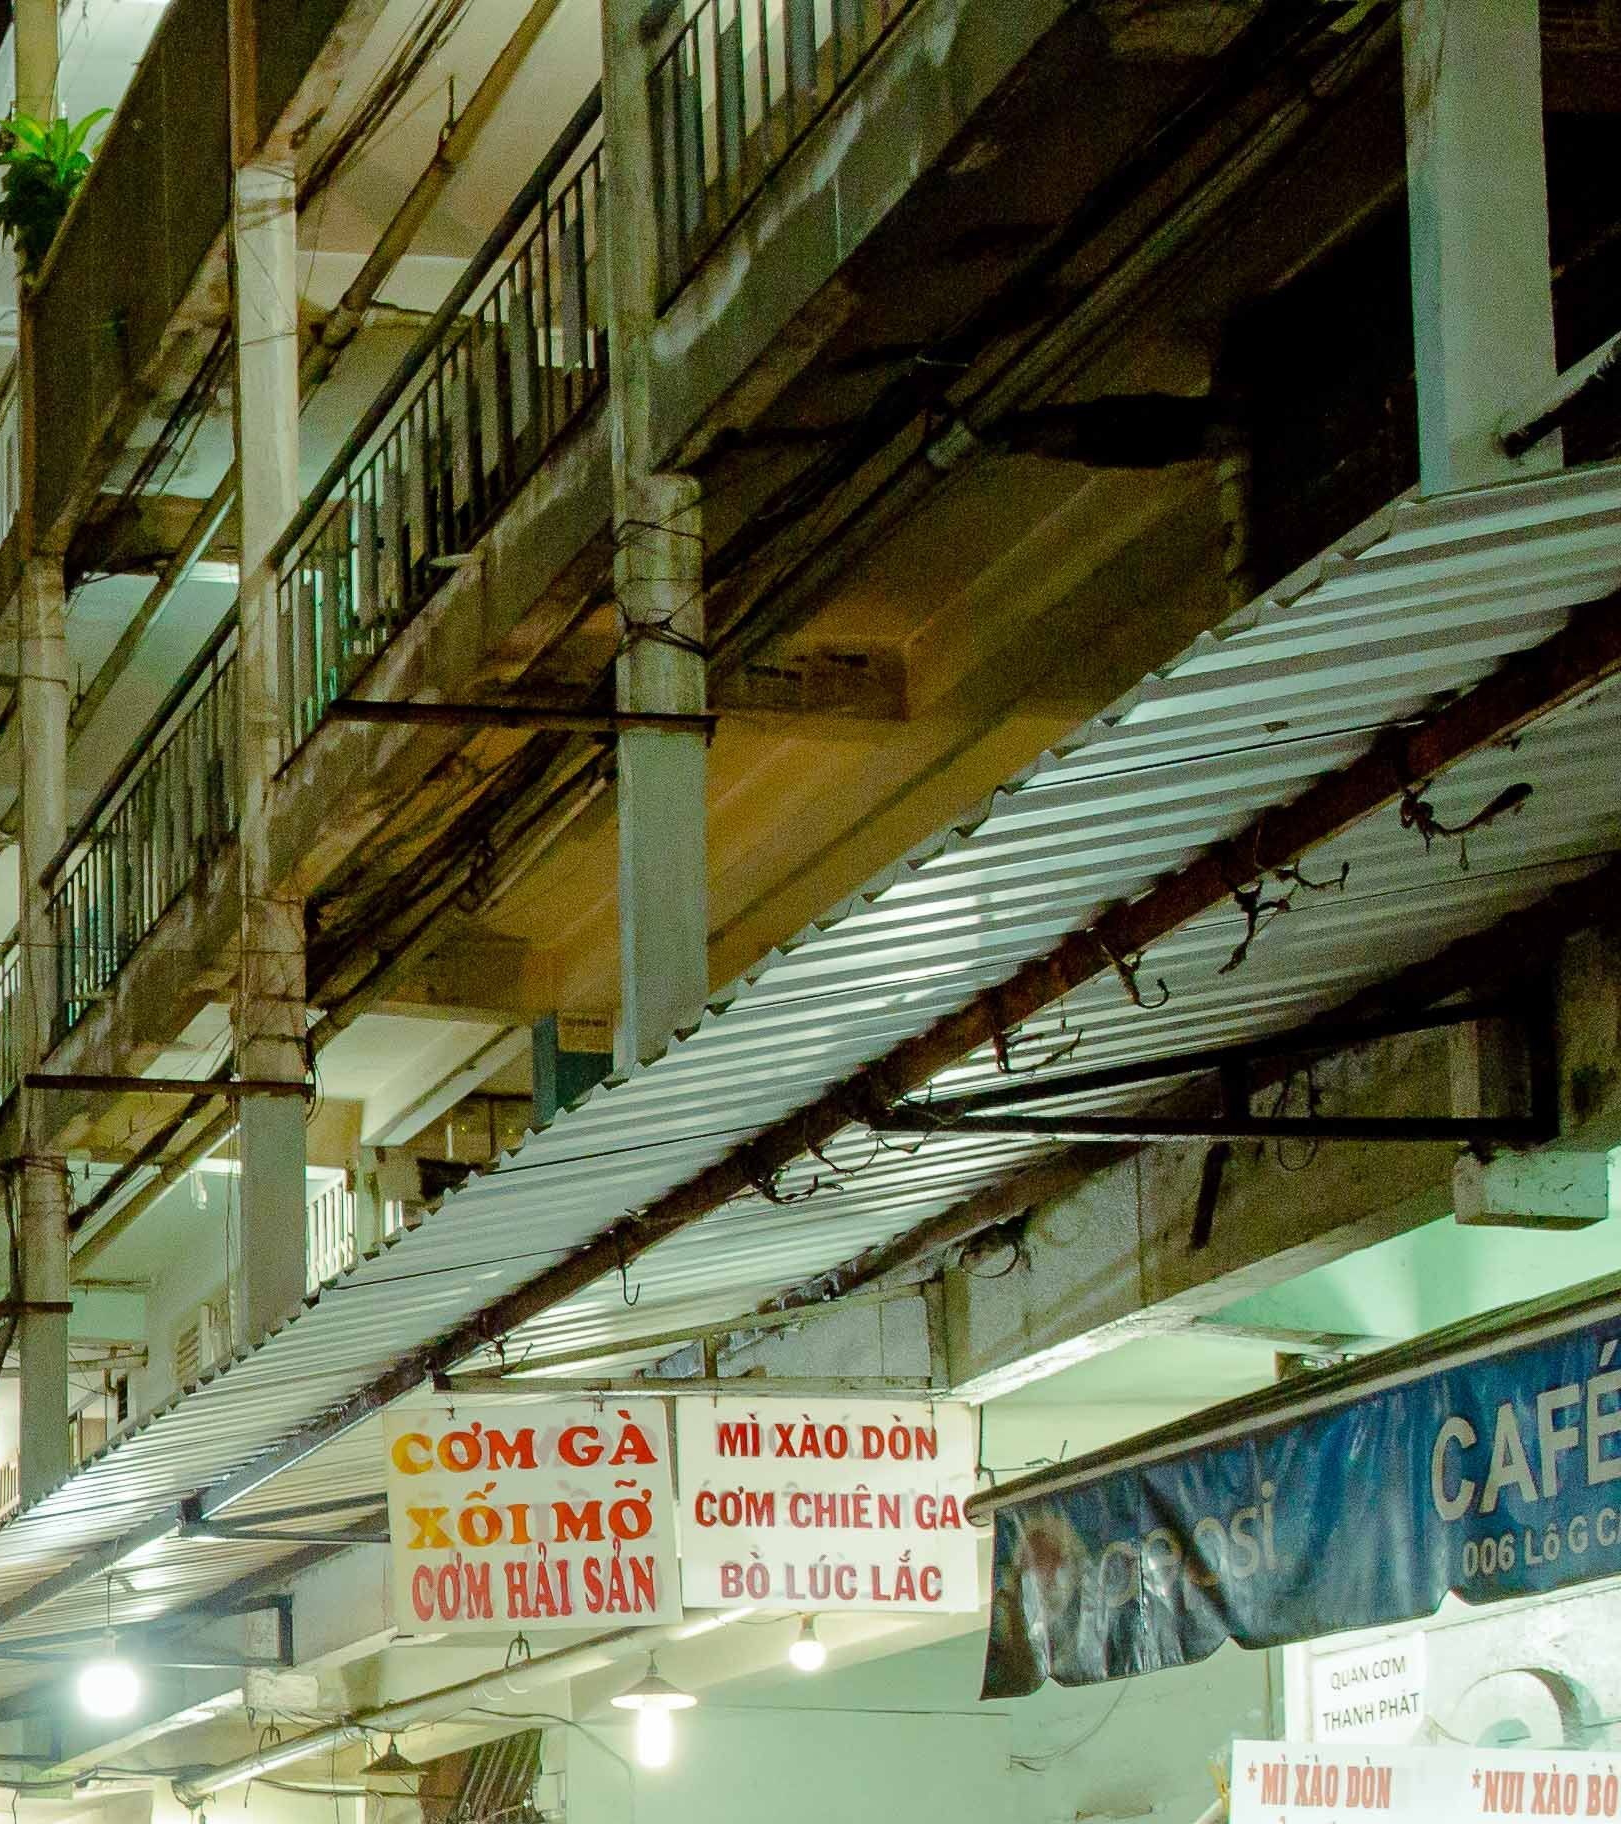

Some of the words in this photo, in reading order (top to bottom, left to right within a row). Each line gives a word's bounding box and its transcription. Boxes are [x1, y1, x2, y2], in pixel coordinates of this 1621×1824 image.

[391, 1421, 538, 1475] CƠM
[557, 1409, 658, 1467] GÀ
[718, 1413, 760, 1457] MÌ
[774, 1413, 848, 1459] XÀO
[861, 1414, 938, 1460] DÒN
[1431, 1339, 1621, 1520] CAFÉ
[406, 1481, 532, 1549] XỐI
[551, 1479, 652, 1542] MỠ
[695, 1486, 774, 1528] CƠM
[789, 1484, 900, 1528] CHIÊN
[1462, 1530, 1515, 1577] 006
[1524, 1523, 1560, 1565] Lô
[1568, 1515, 1589, 1553] G
[412, 1552, 493, 1621] CƠM
[504, 1542, 573, 1618] HẢI
[582, 1536, 657, 1613] SẢN
[720, 1552, 770, 1600] BÒ
[785, 1554, 857, 1600] LÚC
[871, 1550, 942, 1602] LẮC
[1372, 1656, 1405, 1680] CƠM
[1323, 1703, 1374, 1732] THANH
[1294, 1754, 1339, 1808] XÀO
[1345, 1755, 1393, 1809] DÒN
[1483, 1770, 1525, 1814] NUI
[1531, 1763, 1578, 1816] XÀO
[1586, 1763, 1619, 1817] BÒ
